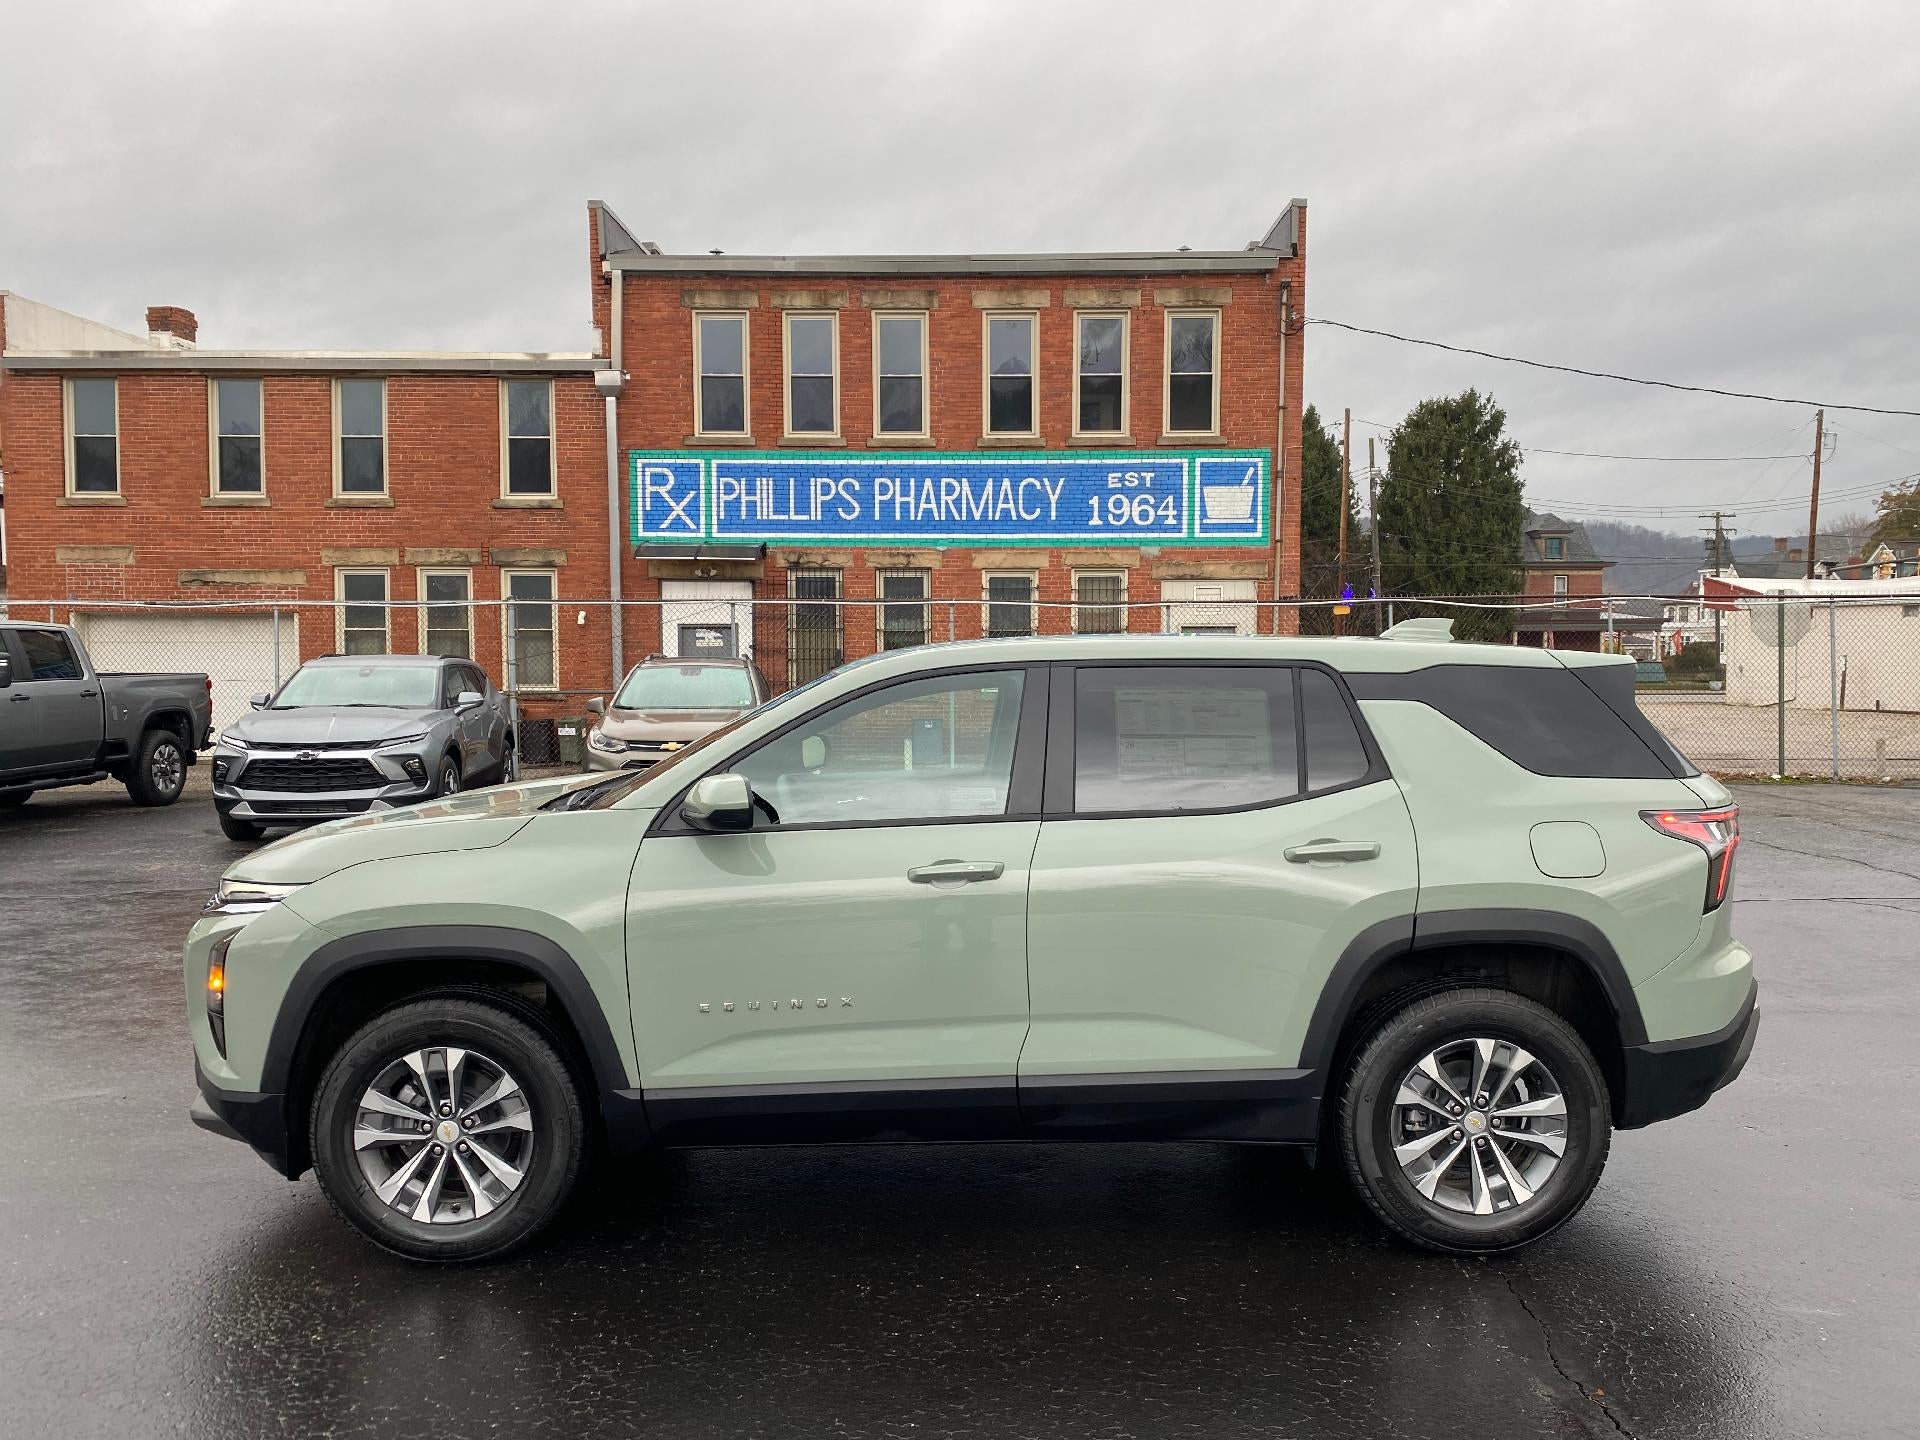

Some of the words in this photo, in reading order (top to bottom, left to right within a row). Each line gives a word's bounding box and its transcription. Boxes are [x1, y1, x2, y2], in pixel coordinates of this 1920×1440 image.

[1107, 472, 1155, 488] EST
[719, 477, 861, 520] PHILLIPS
[874, 477, 1065, 521] PHARMACY
[1088, 493, 1178, 526] 1964
[699, 996, 853, 1014] EQUINOX
